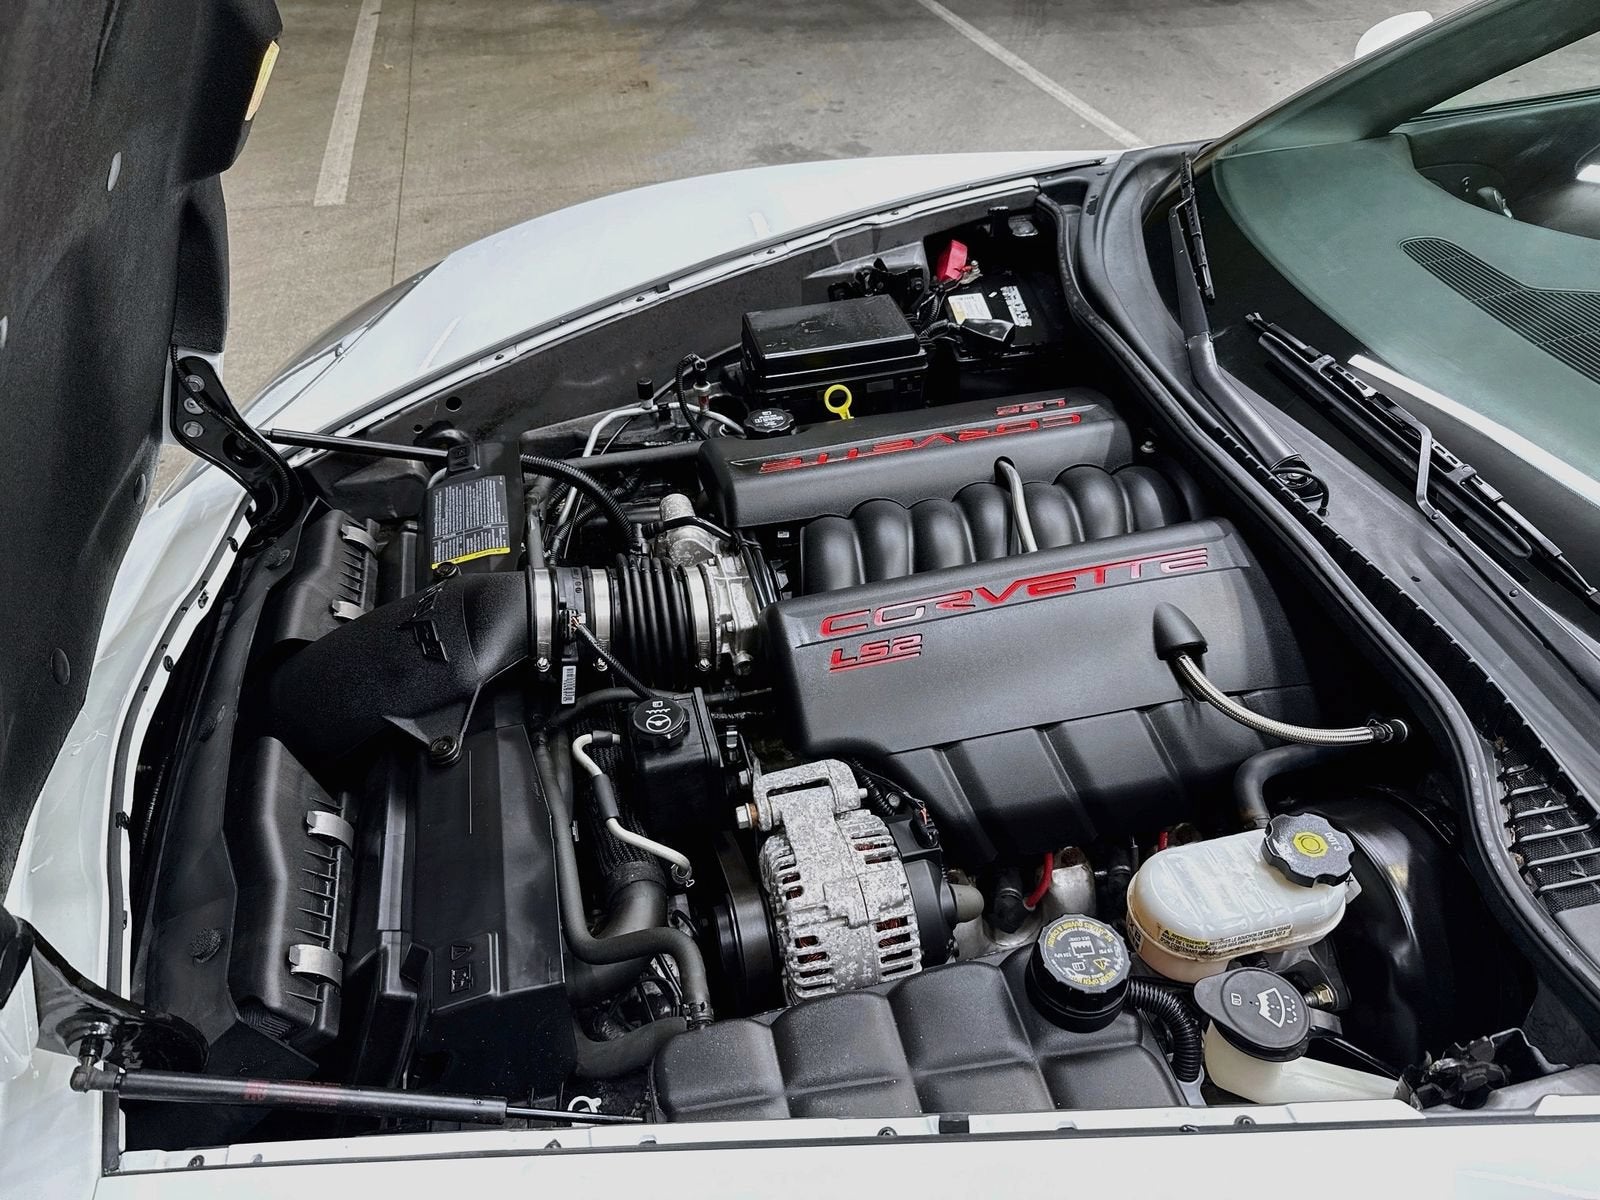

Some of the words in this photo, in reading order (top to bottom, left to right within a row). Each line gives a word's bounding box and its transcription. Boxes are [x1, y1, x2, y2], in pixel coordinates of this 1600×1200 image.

[759, 413, 1081, 474] CORVETTE
[819, 547, 1208, 638] CORVETTE
[830, 633, 923, 670] LS2
[1325, 832, 1340, 846] DOT
